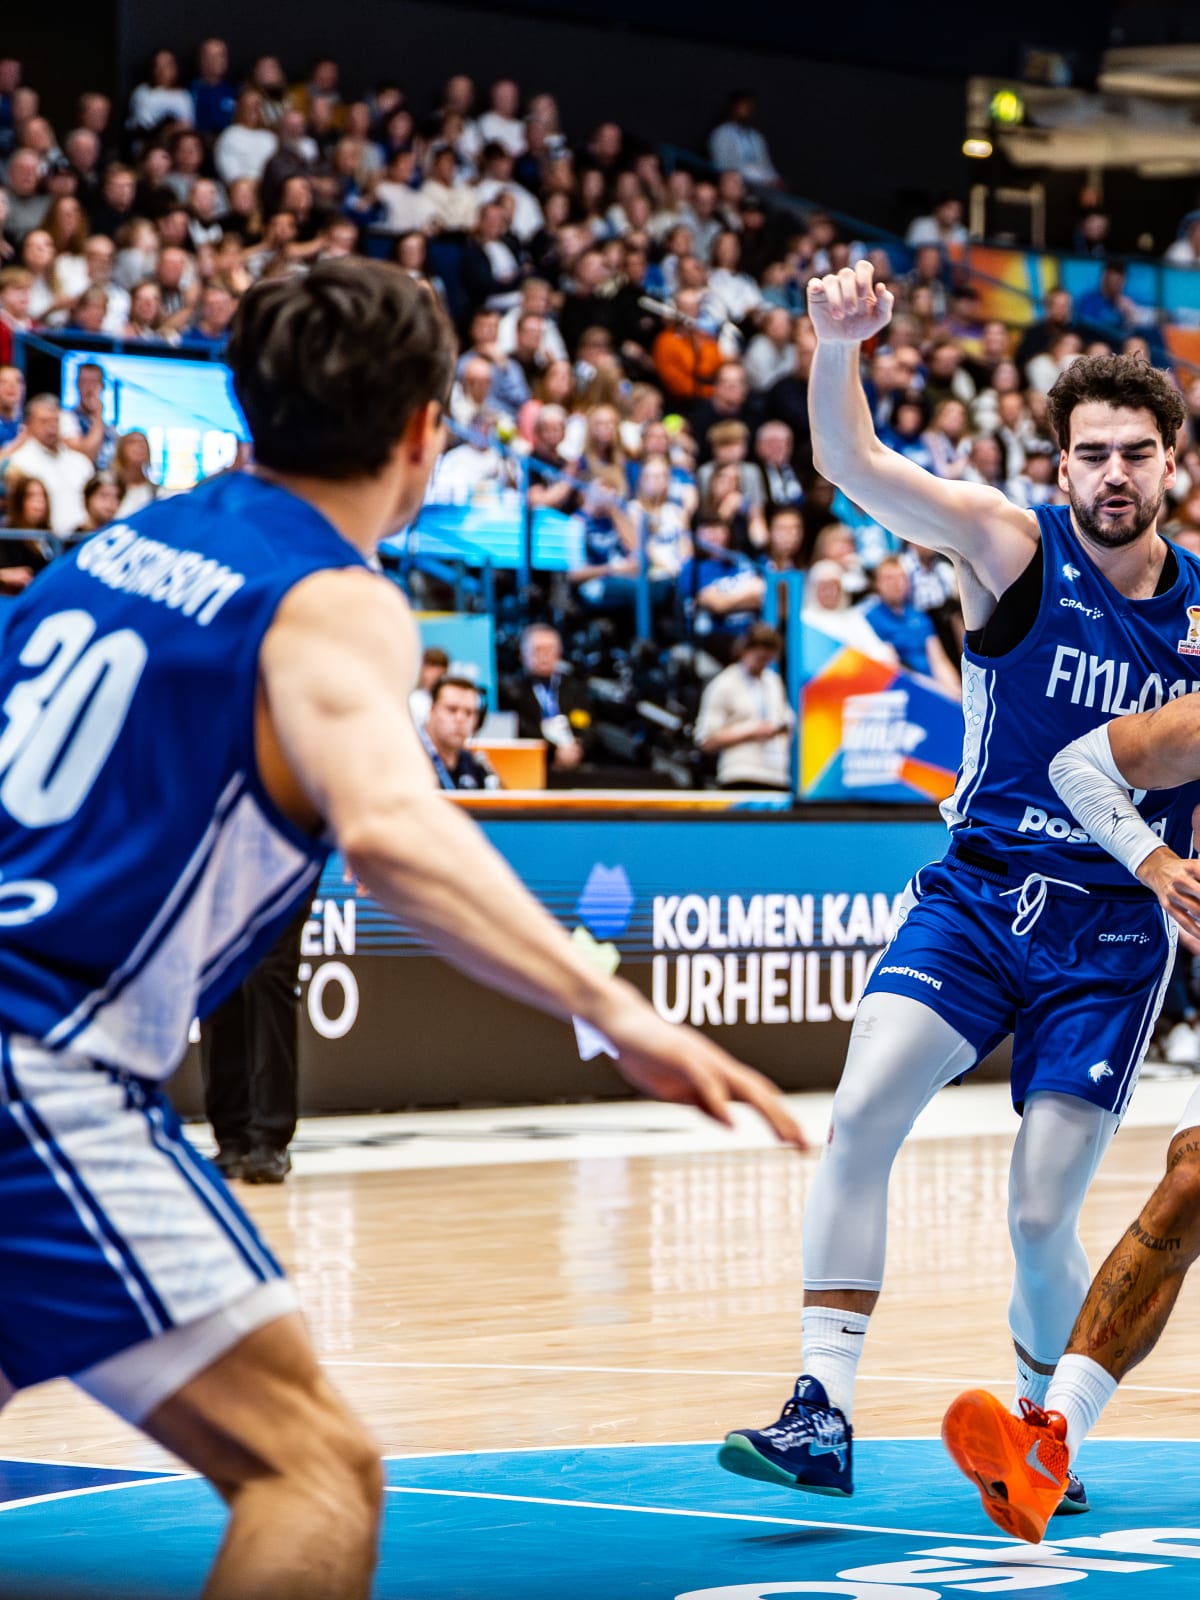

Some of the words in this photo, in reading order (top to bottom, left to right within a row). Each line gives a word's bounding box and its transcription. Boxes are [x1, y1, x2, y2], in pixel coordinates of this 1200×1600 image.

[0, 609, 148, 829] 30
[652, 893, 814, 950] KOLMEN
[822, 892, 905, 947] KAM
[1098, 933, 1140, 942] CRAFT
[651, 950, 885, 1026] URHEILU
[878, 966, 943, 991] postnord
